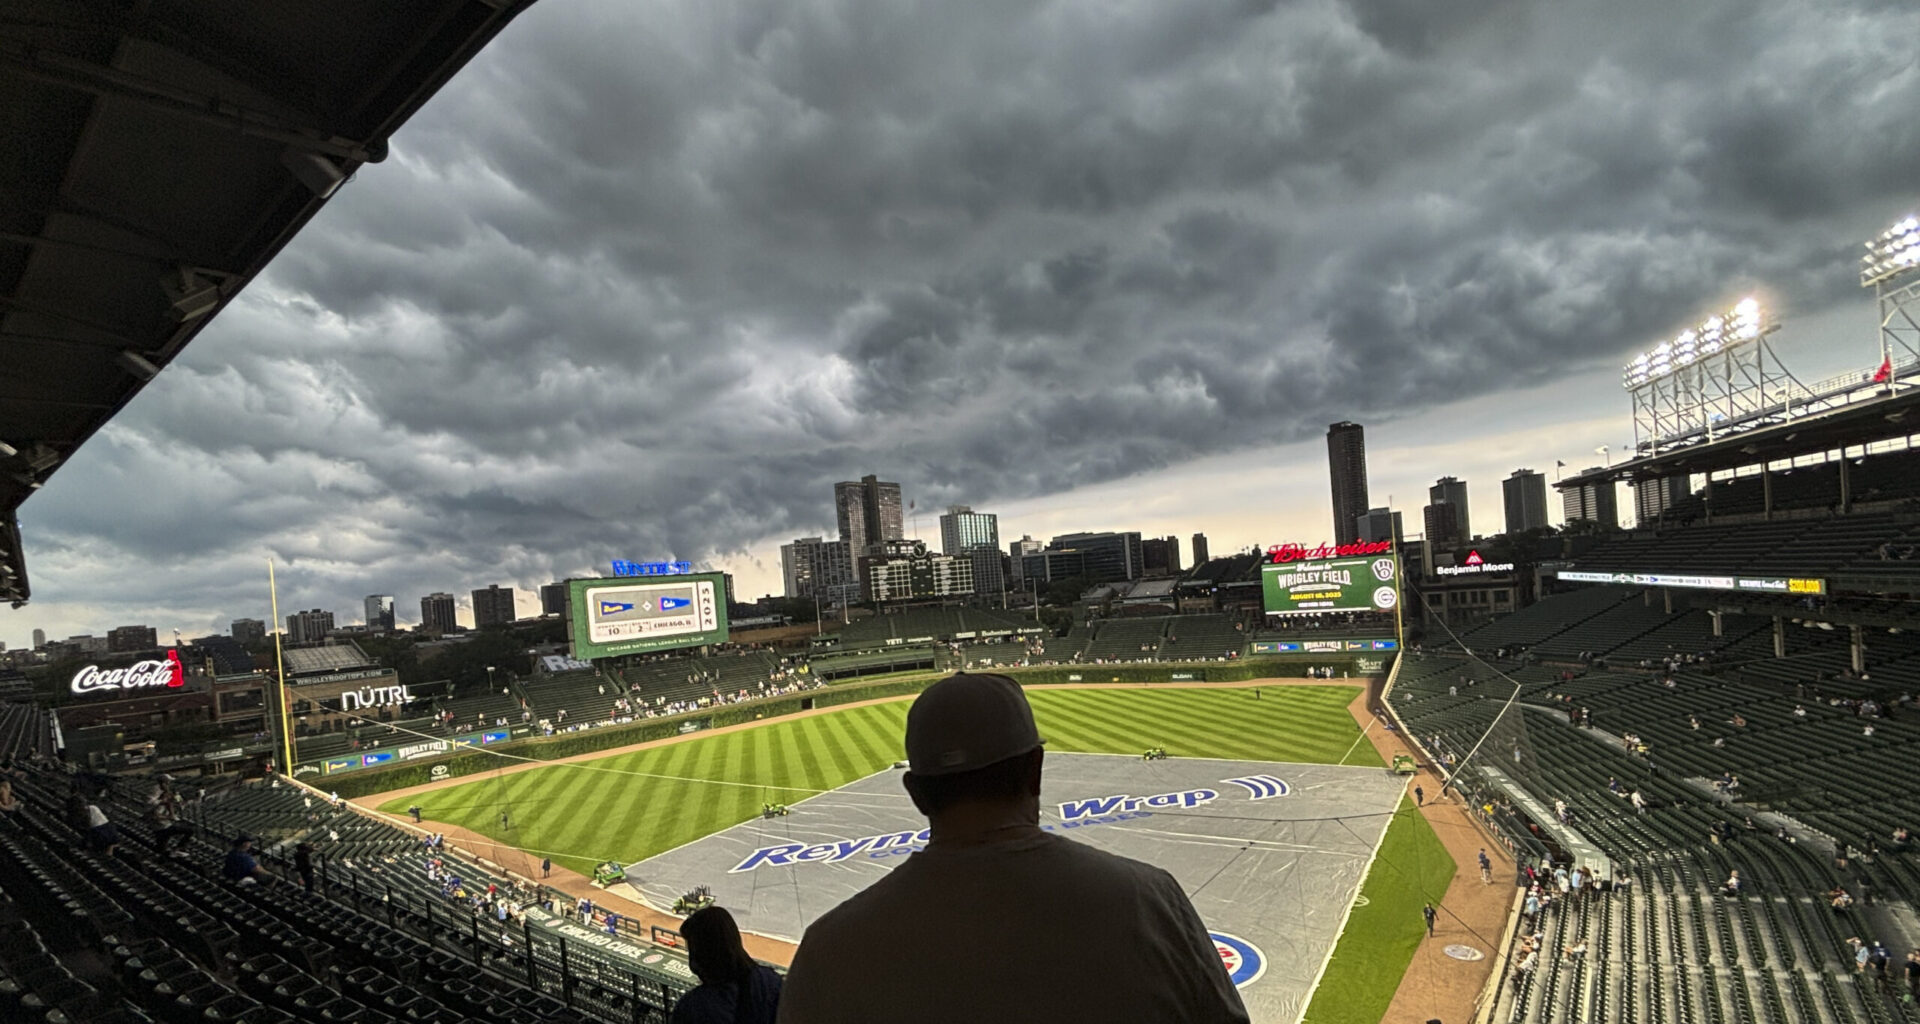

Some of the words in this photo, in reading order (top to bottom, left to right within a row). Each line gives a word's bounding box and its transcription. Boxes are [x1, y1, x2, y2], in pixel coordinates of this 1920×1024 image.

[1269, 538, 1391, 563] Budweiser
[1278, 571, 1320, 589] WRIGLEY
[1322, 570, 1352, 585] FIELD
[1437, 565, 1480, 576] Benjamin
[1482, 563, 1514, 572] Moore
[702, 588, 713, 625] 2025
[607, 644, 631, 652] CHICAGO
[341, 685, 416, 711] NÜTRL
[398, 744, 428, 759] WRIGLEY
[429, 740, 448, 751] FIELD
[1058, 788, 1219, 821] Wrap
[1062, 811, 1153, 829] BASES
[557, 924, 612, 946] CHICAGO
[605, 940, 647, 959] CUBS
